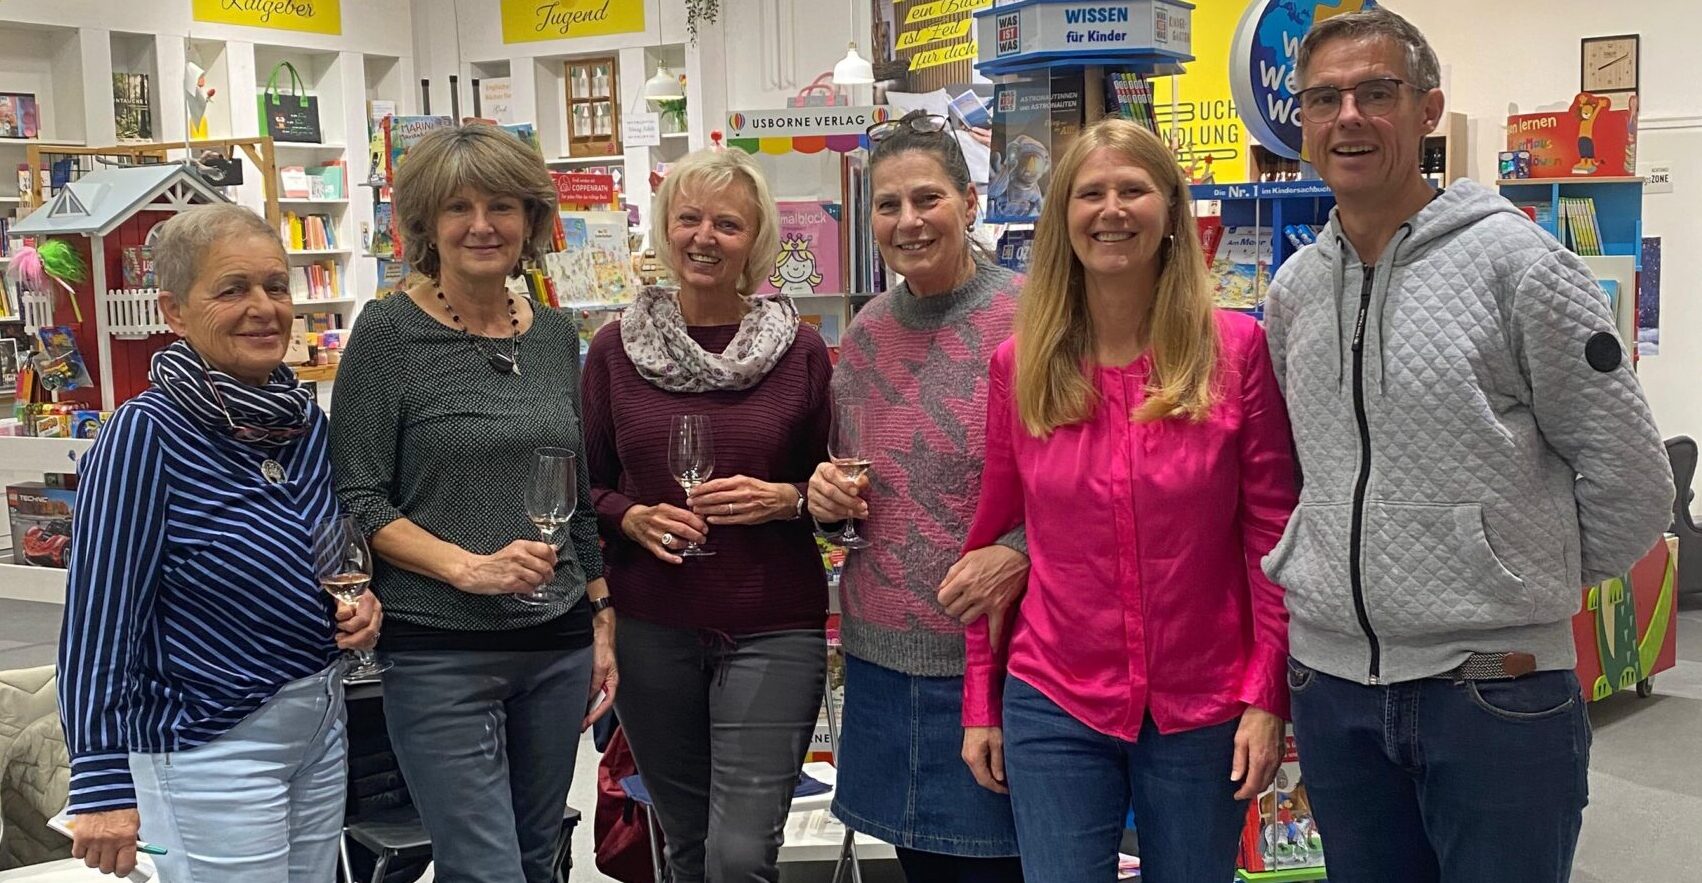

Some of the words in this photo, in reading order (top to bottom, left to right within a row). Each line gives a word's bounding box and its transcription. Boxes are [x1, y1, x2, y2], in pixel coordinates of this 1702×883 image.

[912, 6, 935, 20] ein
[941, 0, 986, 13] Buc
[1065, 7, 1128, 24] WISSEN
[535, 0, 609, 35] Jugend
[998, 15, 1018, 28] WAS
[904, 29, 921, 45] ist
[927, 19, 960, 42] Zeit
[1002, 28, 1015, 40] IST
[1066, 30, 1084, 43] für
[1087, 29, 1127, 42] Kinder
[945, 40, 977, 60] dich
[999, 39, 1018, 53] WAS
[1020, 92, 1078, 102] ASTRONAUTINNEN
[1031, 100, 1077, 110] ASTRONAUTEN
[752, 117, 811, 128] USBORNE
[815, 115, 866, 127] VERLAG
[1519, 116, 1557, 133] lernen
[1162, 124, 1239, 147] NDLUNG
[571, 184, 609, 192] COPPENRATH
[1228, 186, 1250, 198] Nr.
[1253, 185, 1258, 197] 1
[1272, 185, 1331, 195] Kindersachbuch
